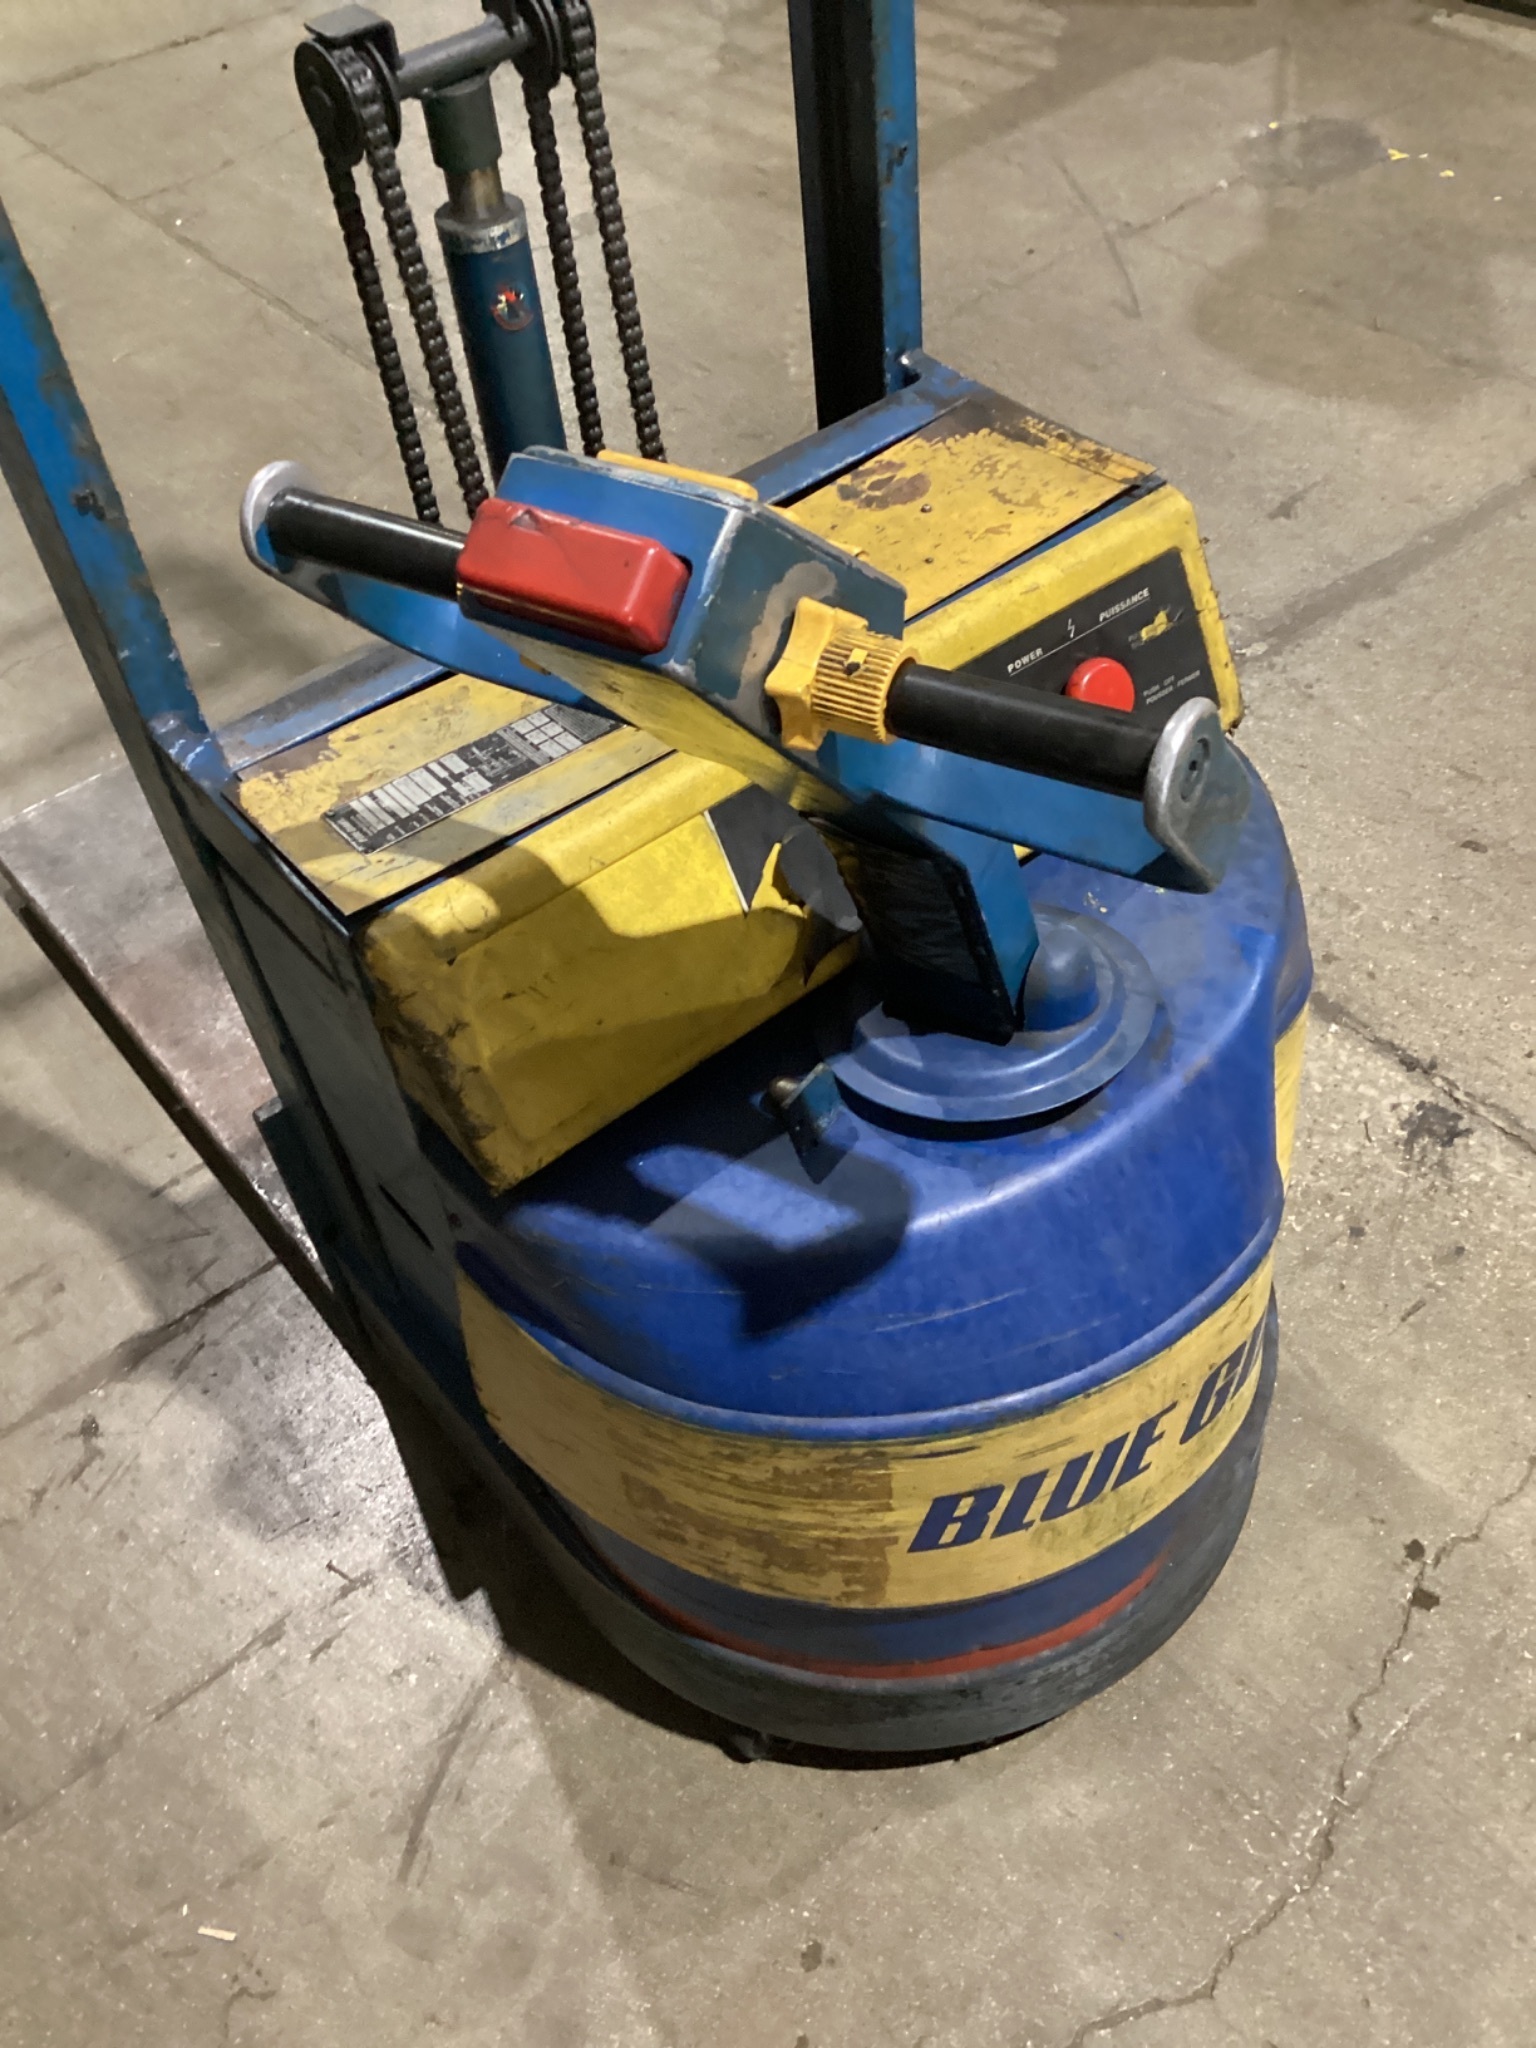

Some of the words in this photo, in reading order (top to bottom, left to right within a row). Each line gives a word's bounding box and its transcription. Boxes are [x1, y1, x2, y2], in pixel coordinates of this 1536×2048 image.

[1007, 647, 1043, 673] POWER
[1099, 587, 1150, 622] PUISSANCE
[908, 1401, 1178, 1553] BLUE
